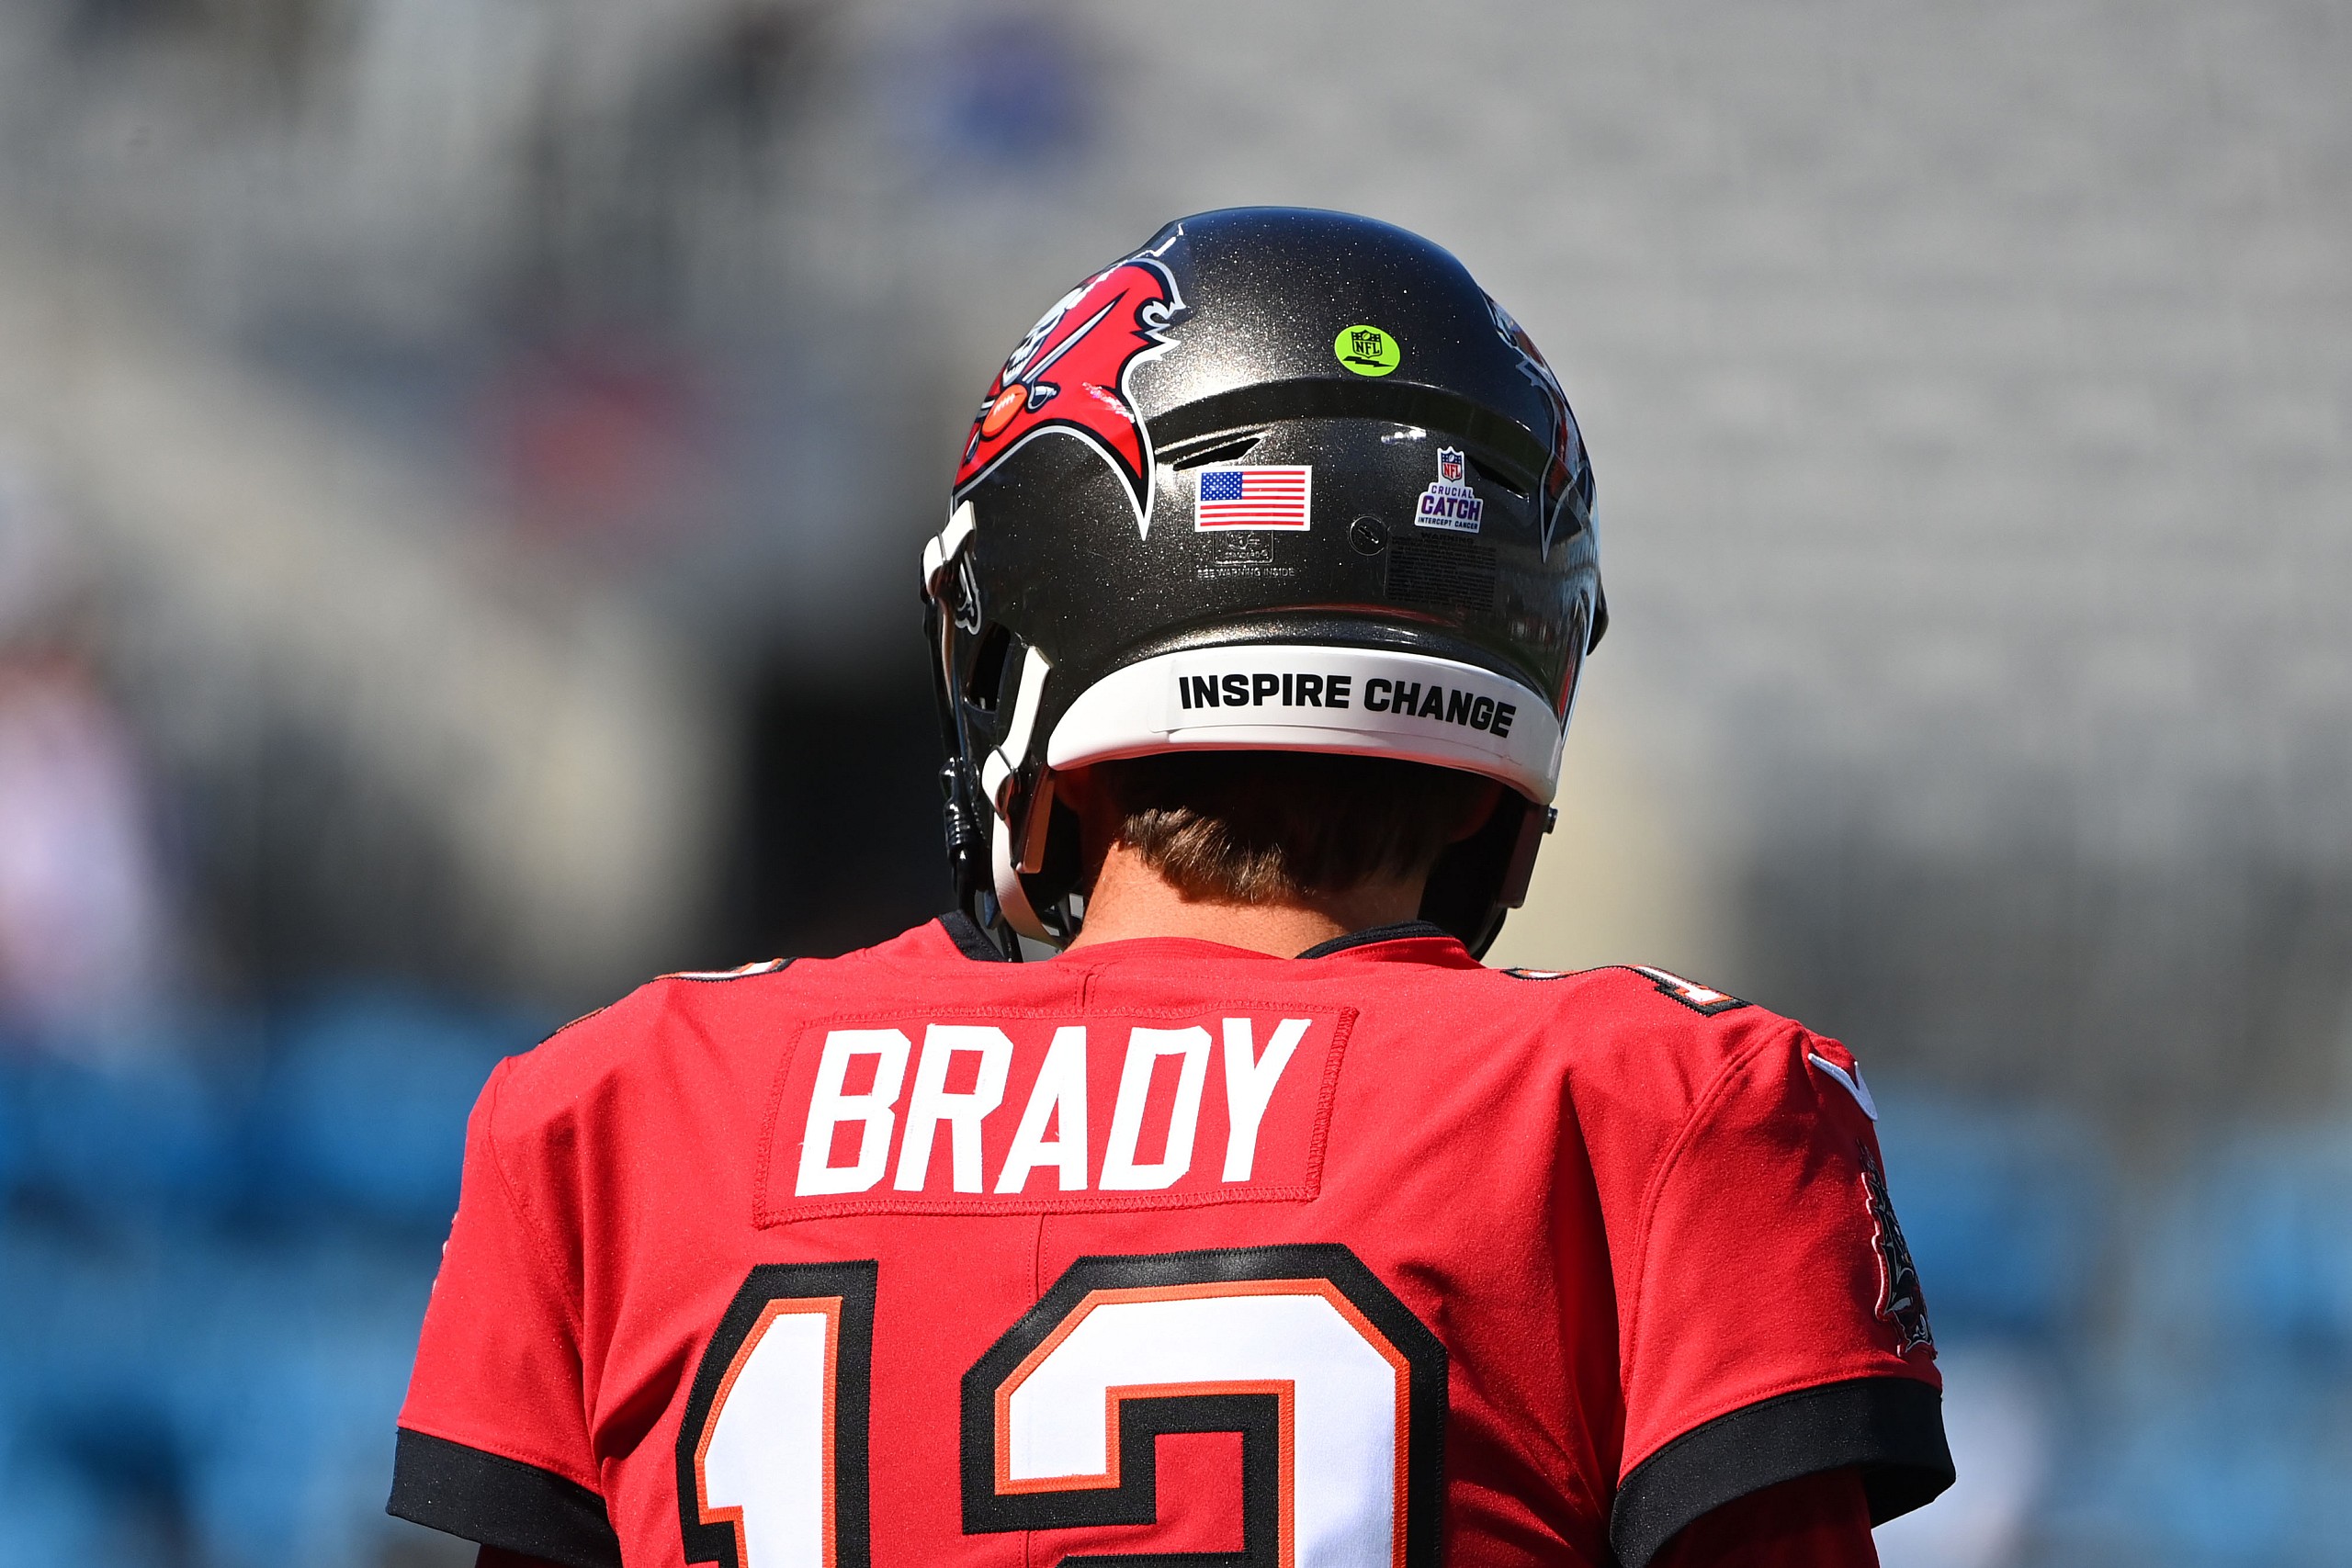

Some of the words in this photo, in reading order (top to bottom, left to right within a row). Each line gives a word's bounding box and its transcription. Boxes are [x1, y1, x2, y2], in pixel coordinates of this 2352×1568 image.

[1354, 341, 1380, 355] NFL
[1443, 463, 1461, 479] NFL
[1430, 485, 1473, 499] CRUCIAL
[1420, 495, 1481, 521] CATCH
[1418, 516, 1452, 526] INTERCEPT
[1454, 520, 1478, 530] CANCER
[1263, 567, 1295, 577] INSIDE
[1179, 673, 1351, 709] INSPIRE
[1363, 678, 1517, 739] CHANGE
[795, 1018, 1312, 1198] BRADY
